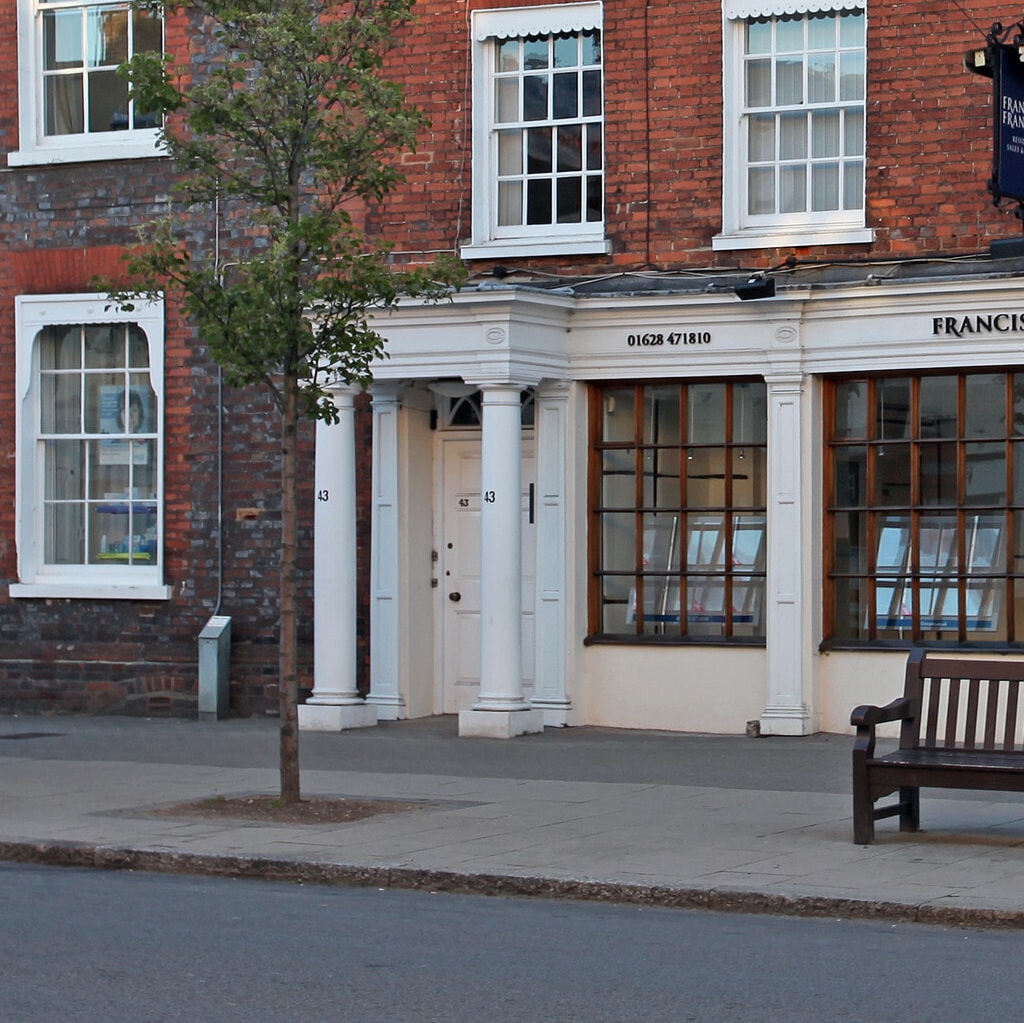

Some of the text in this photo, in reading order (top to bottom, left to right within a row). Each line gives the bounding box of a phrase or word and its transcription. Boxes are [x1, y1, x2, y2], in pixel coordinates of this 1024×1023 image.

[627, 331, 711, 347] 01628 471810
[317, 489, 329, 502] 43
[484, 490, 496, 503] 43
[458, 497, 470, 508] 43
